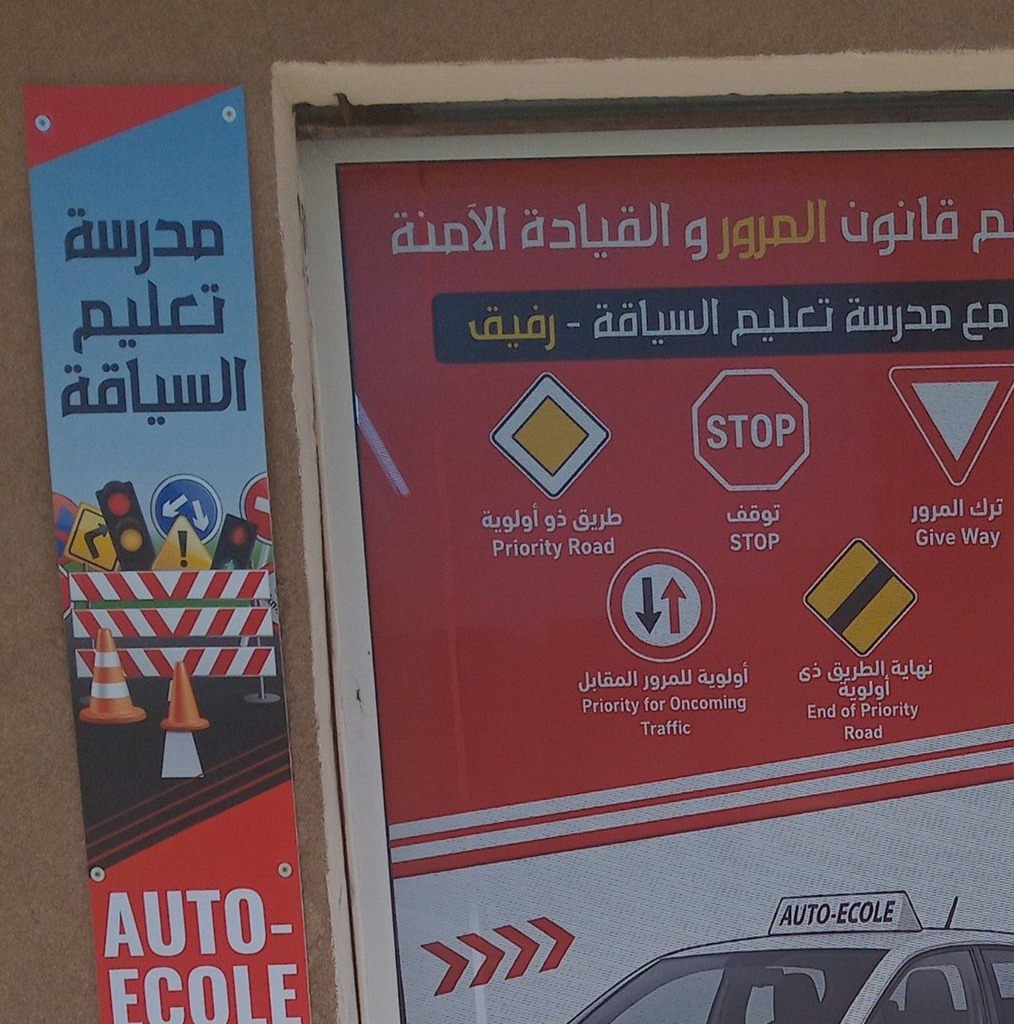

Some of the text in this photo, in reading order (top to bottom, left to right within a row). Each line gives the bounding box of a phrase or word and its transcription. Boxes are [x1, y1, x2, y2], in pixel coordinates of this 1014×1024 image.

[65, 208, 224, 275] مدرسة
[521, 202, 669, 258] القيادة
[684, 216, 708, 261] و
[717, 198, 827, 260] المرور
[841, 196, 958, 256] قانون
[72, 280, 225, 354] تعليم
[469, 304, 556, 351] رفيق
[594, 298, 718, 345] السياقة
[732, 297, 834, 346] تعليم
[846, 297, 951, 343] مدرسة
[963, 301, 1008, 341] مع
[61, 356, 246, 425] السياقة
[706, 413, 796, 449] STOP
[481, 503, 622, 534] طريق ذو أولوية
[727, 505, 780, 526] توقف
[911, 498, 1003, 523] ترك المرور
[493, 537, 615, 560] Priority Road
[730, 533, 780, 552] STOP
[916, 527, 1000, 548] Give Way
[578, 661, 749, 692] أولوية للمرور المقابل
[827, 660, 884, 682] الطريق
[891, 659, 933, 680] نهاية
[839, 674, 890, 701] أولوية
[582, 695, 747, 715] Priority for Oncoming
[807, 702, 919, 719] End of Priority
[640, 720, 691, 736] Traffic
[844, 725, 883, 740] Road
[104, 888, 293, 958] AUTO-
[779, 900, 895, 928] AUTO-ECOLE
